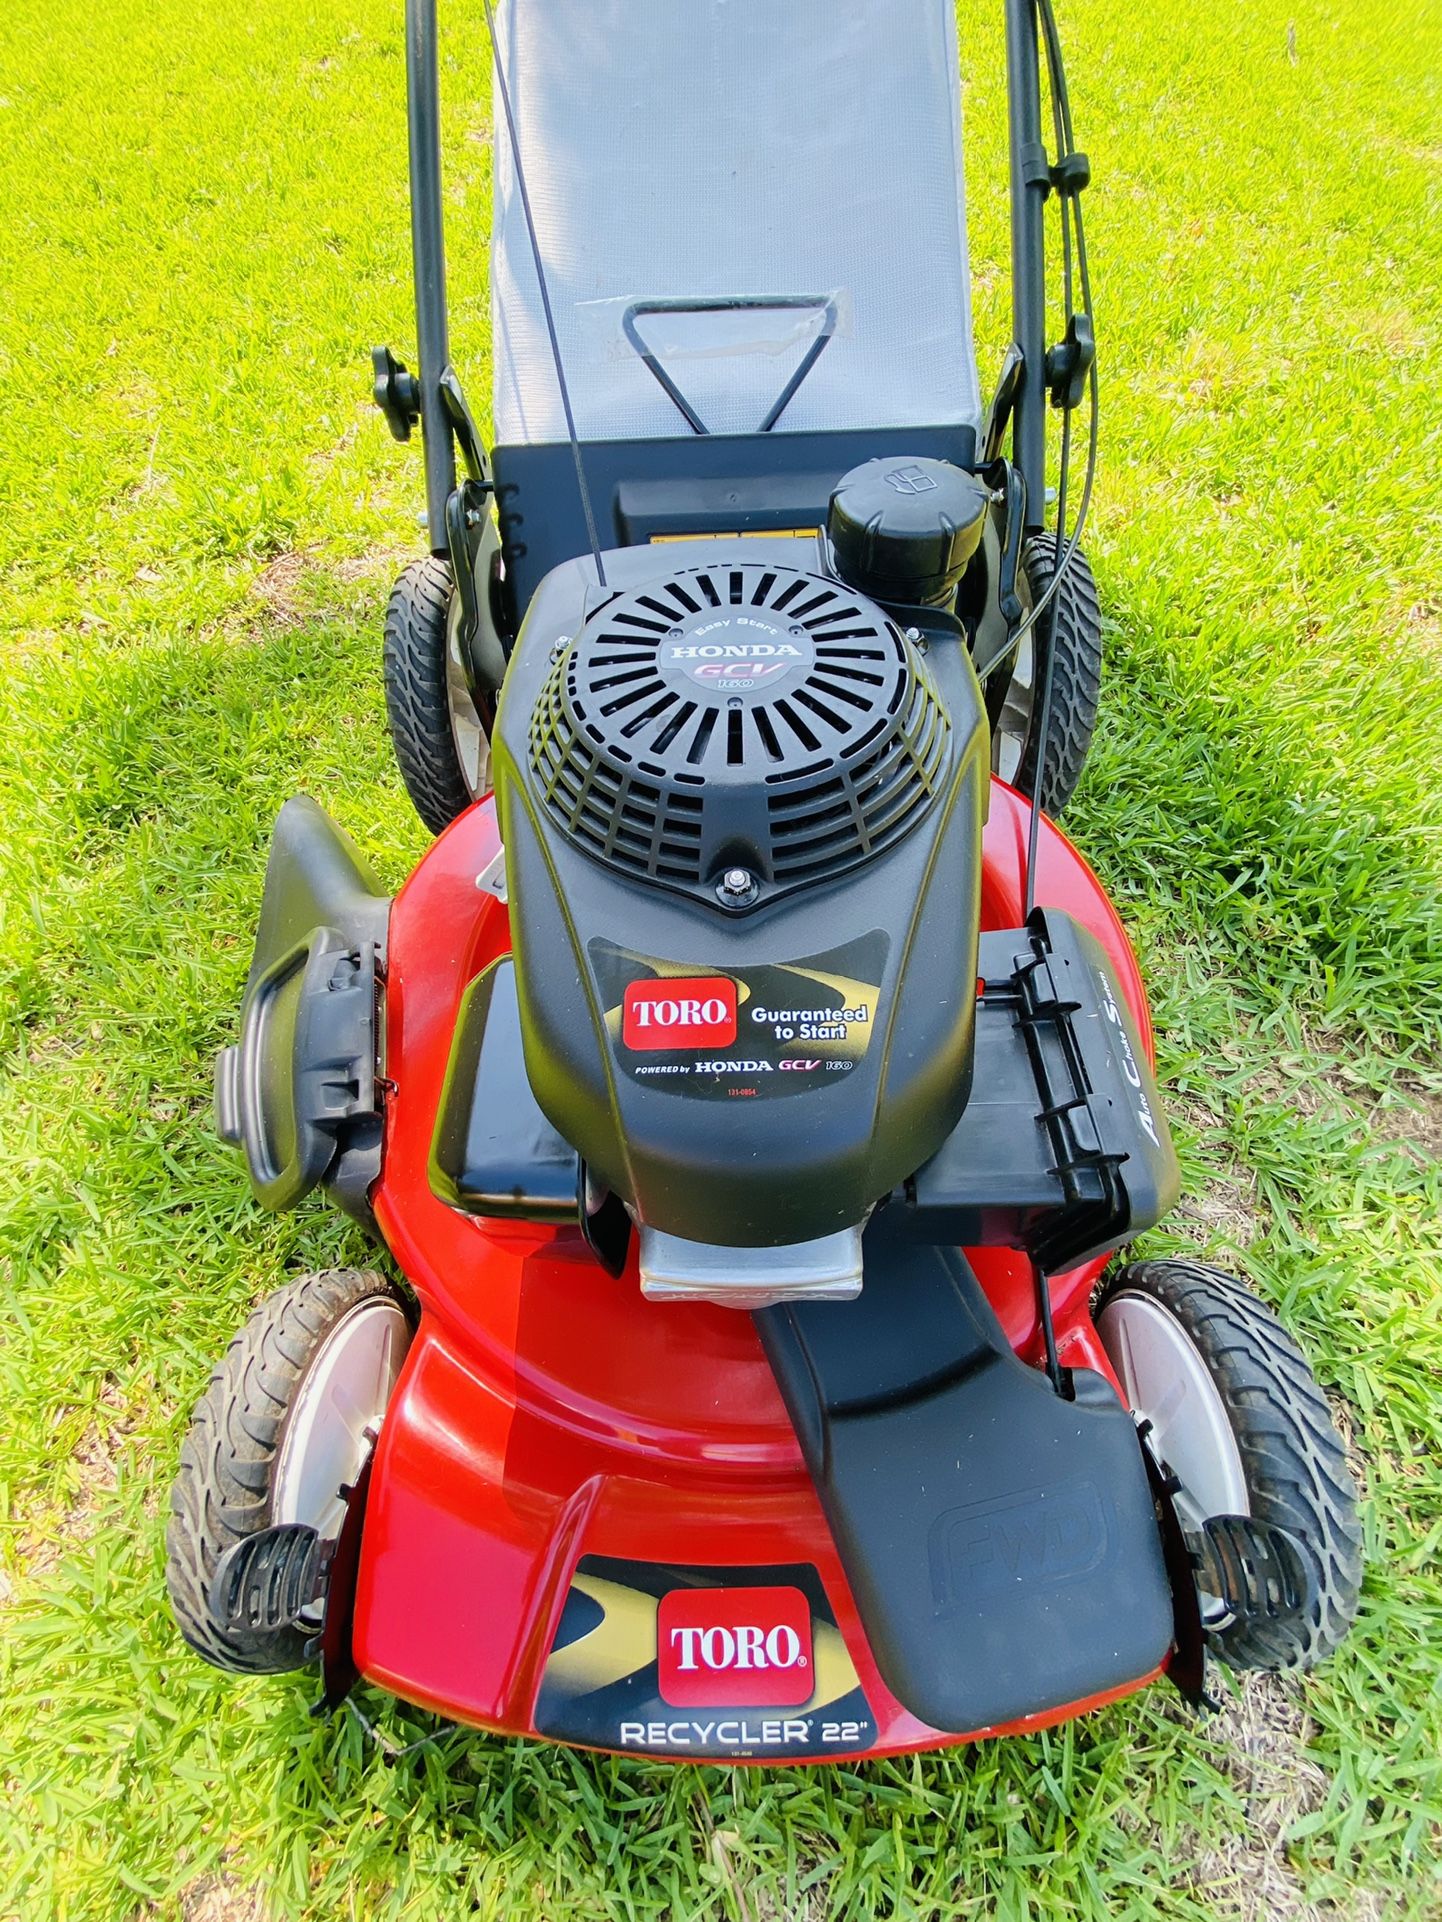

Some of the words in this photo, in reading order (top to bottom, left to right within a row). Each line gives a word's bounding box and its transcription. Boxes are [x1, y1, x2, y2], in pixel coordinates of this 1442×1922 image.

[694, 619, 731, 636] Easy
[736, 617, 779, 635] Start
[671, 644, 802, 658] HONDA
[694, 662, 786, 678] GCV
[717, 679, 754, 689] 160
[1098, 971, 1122, 1027] System
[751, 1005, 868, 1023] Guaranteed
[775, 1025, 793, 1039] to
[799, 1024, 846, 1040] Start
[636, 1066, 679, 1074] POWERED
[680, 1066, 690, 1074] by
[695, 1061, 773, 1072] HONDA
[778, 1060, 821, 1071] GCV
[825, 1061, 853, 1070] 160
[1119, 1031, 1141, 1088] Choke
[1137, 1093, 1160, 1148] Auto
[822, 1722, 868, 1741] 22"
